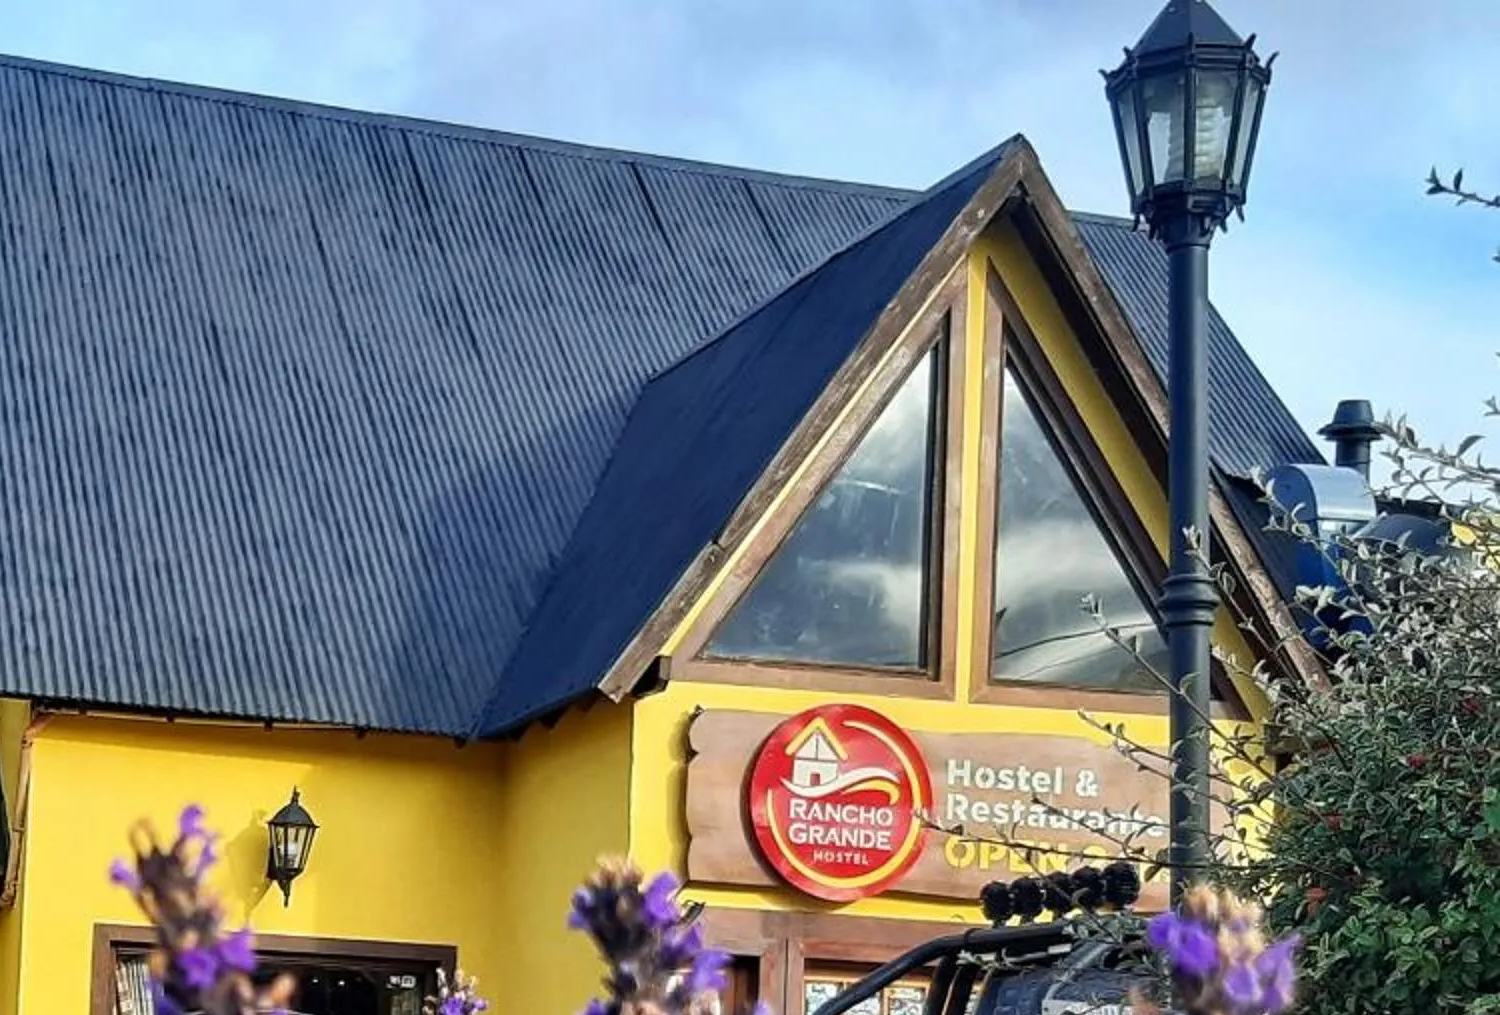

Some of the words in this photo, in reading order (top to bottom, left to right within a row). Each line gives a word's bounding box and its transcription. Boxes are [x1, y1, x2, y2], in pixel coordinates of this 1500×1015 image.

[948, 760, 1063, 794] Hostel
[1075, 770, 1099, 797] &
[789, 798, 893, 826] RANCHO
[947, 793, 1164, 837] Restaurante
[788, 822, 893, 851] GRANDE
[812, 850, 869, 865] HOSTEL
[944, 835, 1071, 876] OPEN
